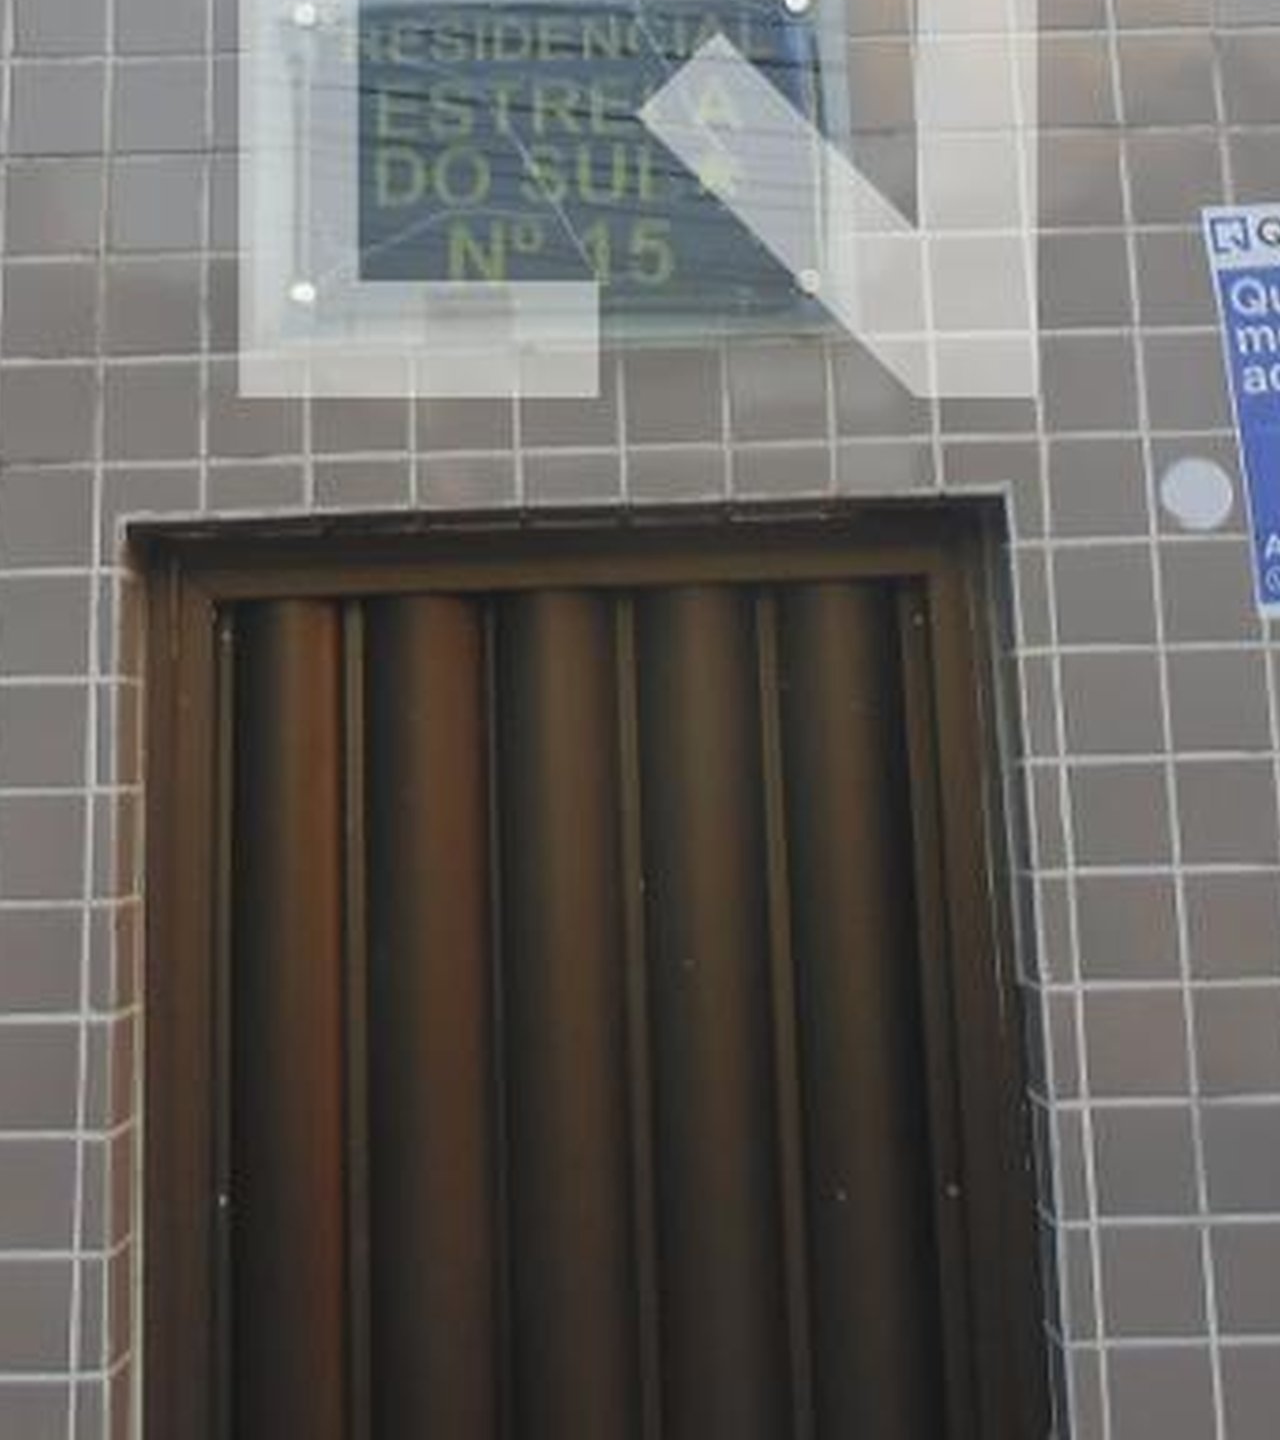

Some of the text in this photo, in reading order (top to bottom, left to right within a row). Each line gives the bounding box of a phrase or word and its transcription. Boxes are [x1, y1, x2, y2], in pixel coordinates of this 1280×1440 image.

[376, 141, 675, 209] DO SUL
[584, 215, 677, 287] 15
